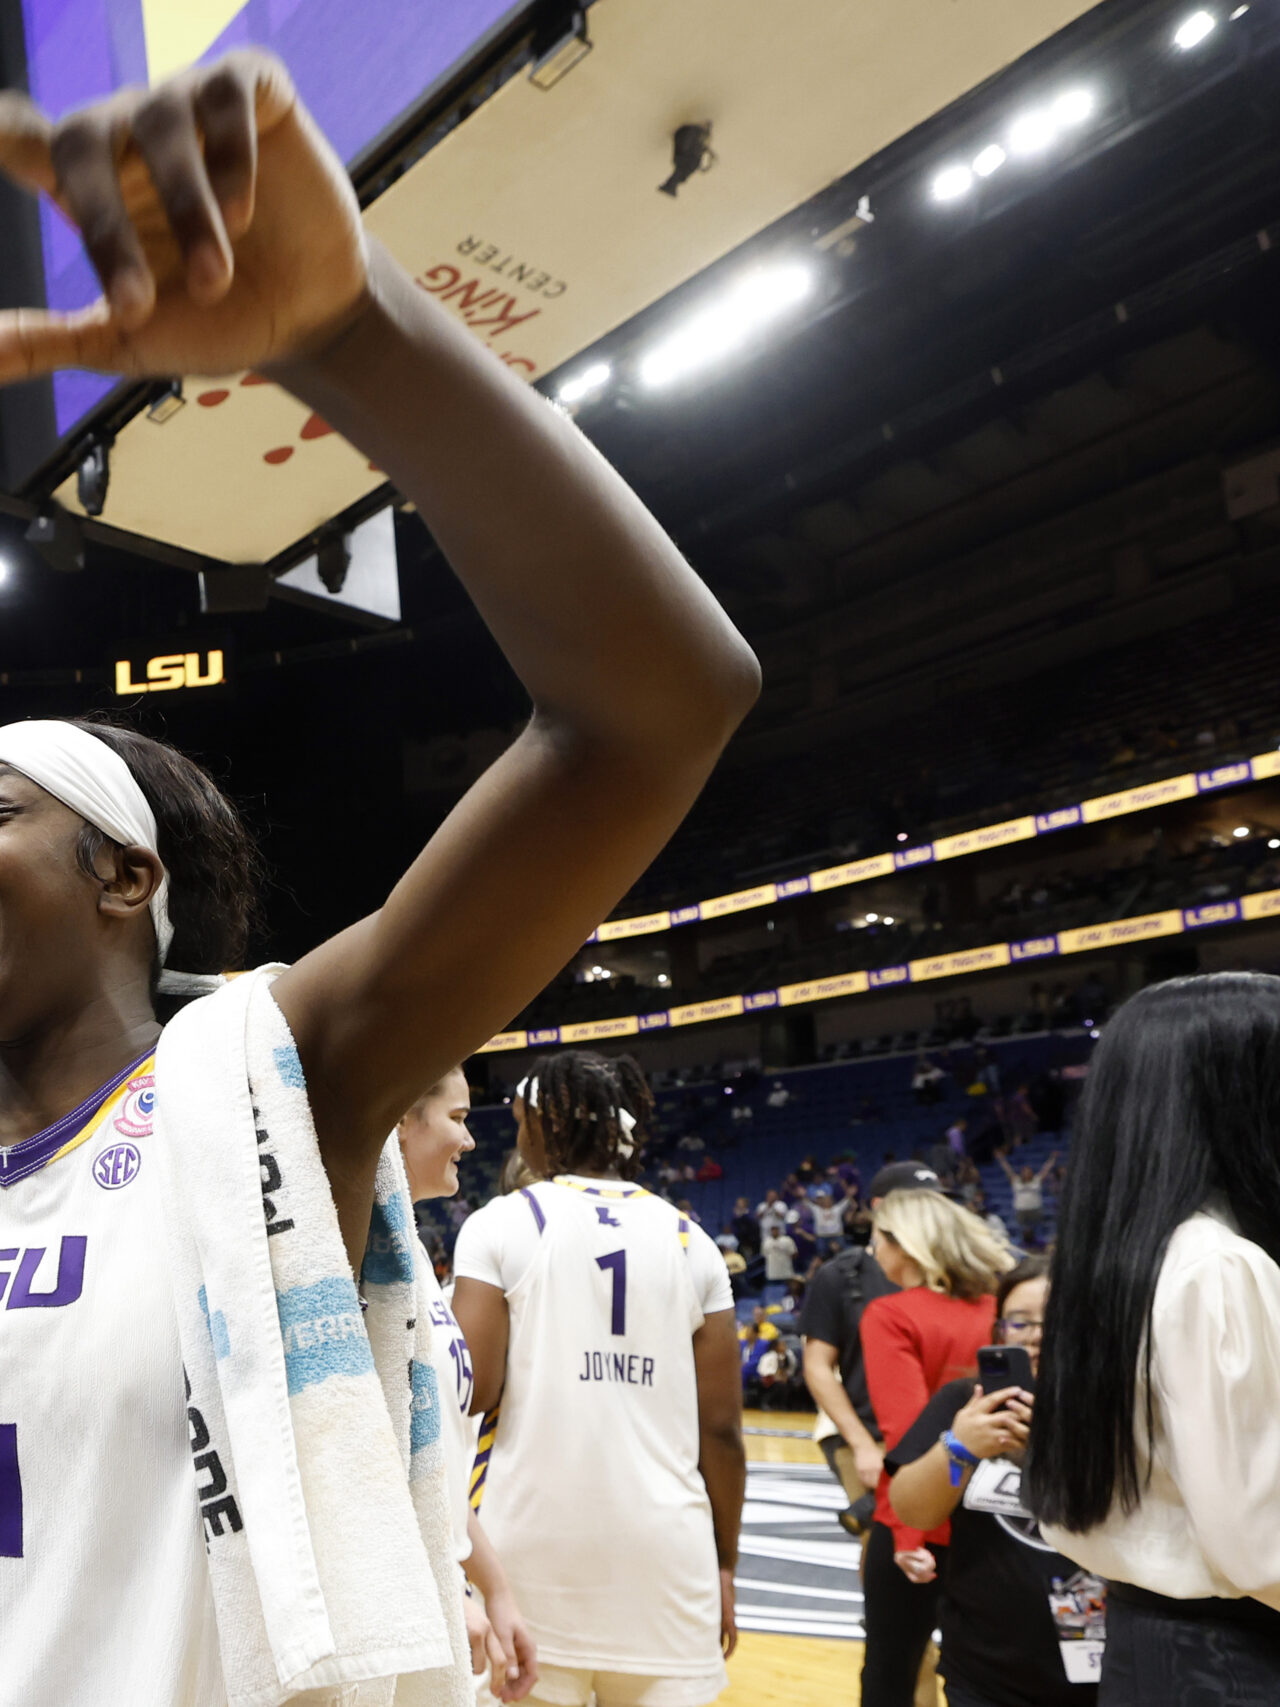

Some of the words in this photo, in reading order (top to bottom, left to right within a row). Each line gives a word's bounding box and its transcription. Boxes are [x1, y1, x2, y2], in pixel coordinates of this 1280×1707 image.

[456, 234, 568, 299] CENTER
[115, 649, 224, 696] LSU
[1185, 901, 1238, 927] LSU
[98, 1147, 137, 1185] SEC
[595, 1248, 627, 1337] 1
[579, 1351, 655, 1387] JOYNER
